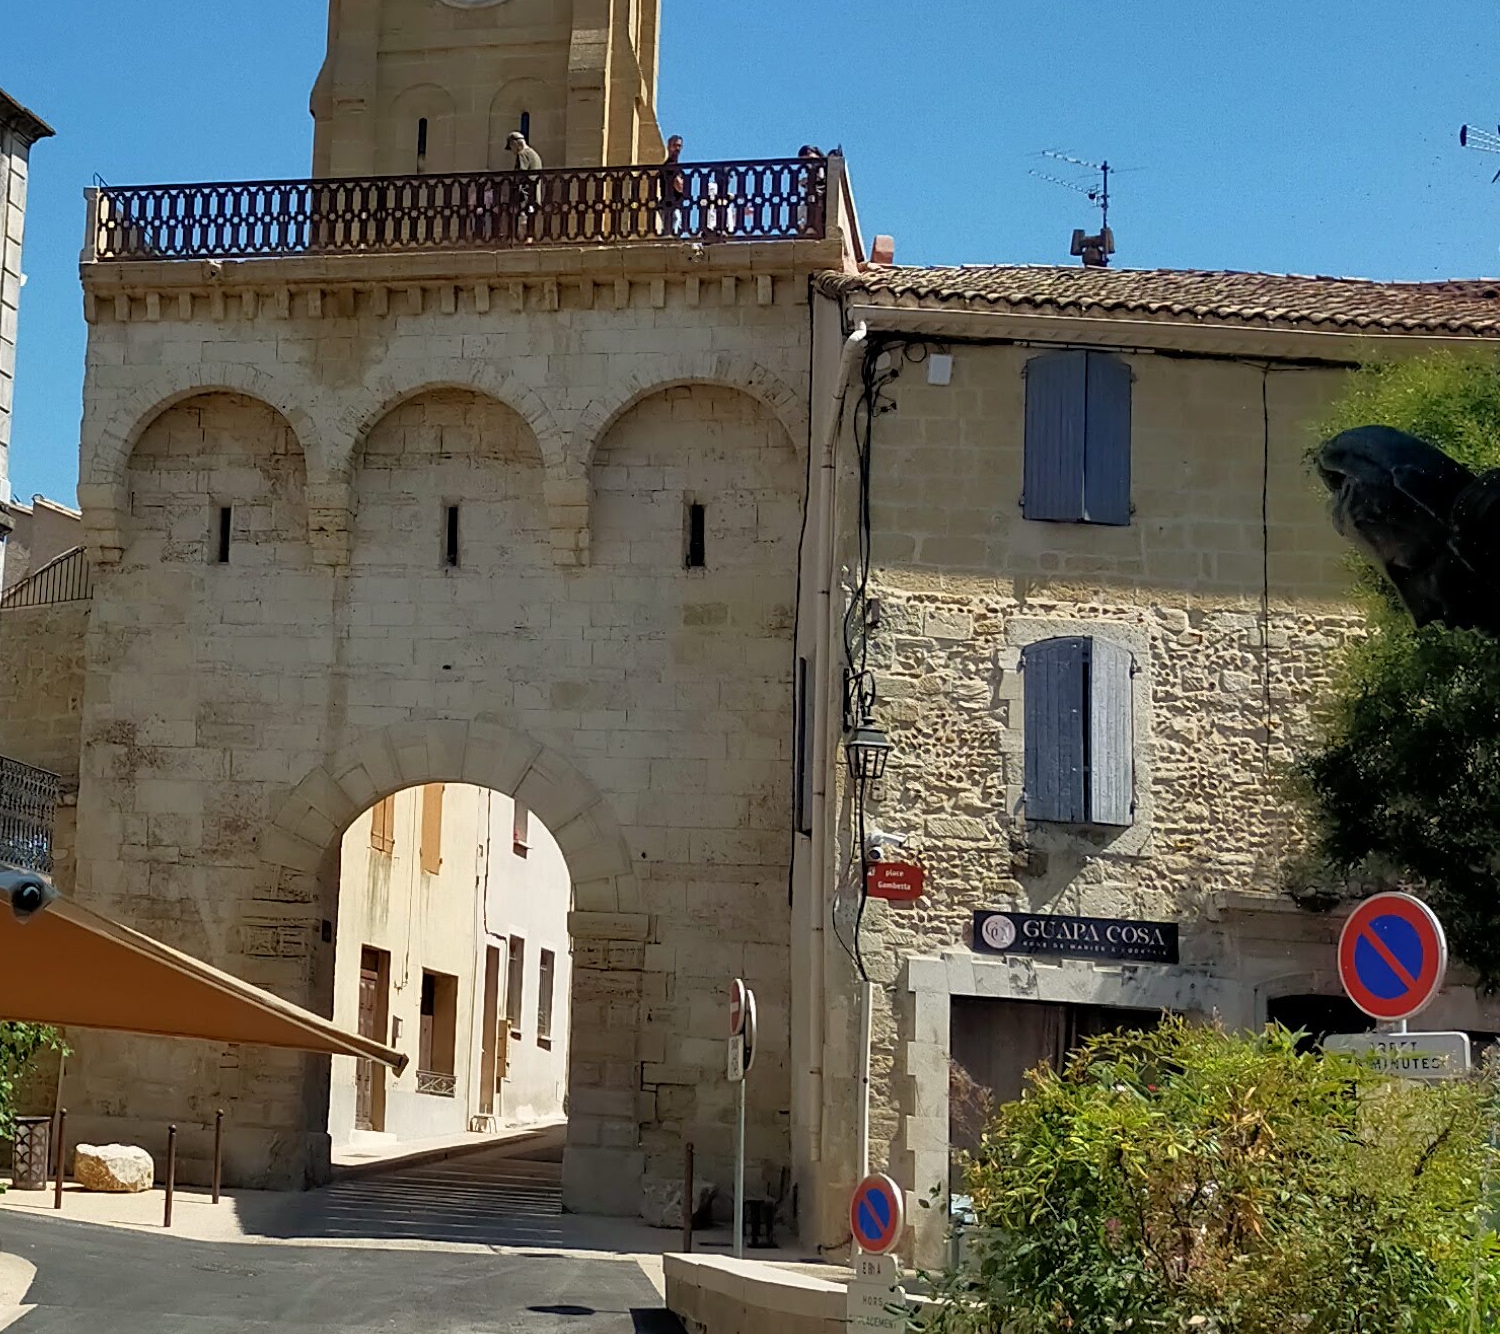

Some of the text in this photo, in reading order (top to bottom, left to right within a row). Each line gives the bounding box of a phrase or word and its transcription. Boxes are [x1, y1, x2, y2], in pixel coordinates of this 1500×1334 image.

[885, 869, 904, 877] place
[877, 880, 912, 891] Gambetta
[1022, 919, 1100, 942] GUAPA
[1106, 925, 1165, 946] COSA
[862, 1295, 883, 1307] HORS
